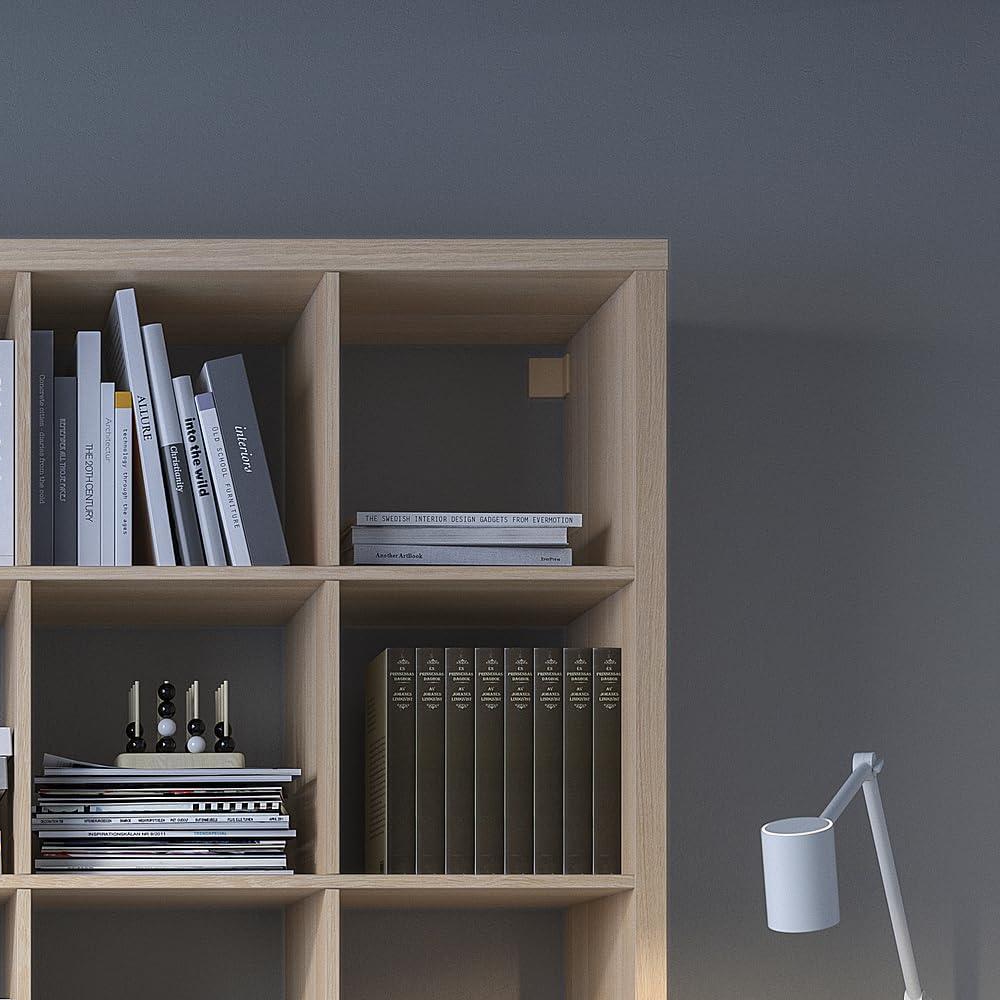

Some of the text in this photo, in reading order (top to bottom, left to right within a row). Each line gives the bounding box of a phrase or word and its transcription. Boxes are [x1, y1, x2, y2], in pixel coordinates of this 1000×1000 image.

[137, 395, 152, 441] ALLURE
[234, 425, 253, 473] interiors
[85, 444, 93, 522] THE 20TH CENTURY
[170, 446, 184, 493] Christianity
[184, 417, 210, 497] into the wild
[212, 426, 240, 529] OLD SCHOOL FURNITURE
